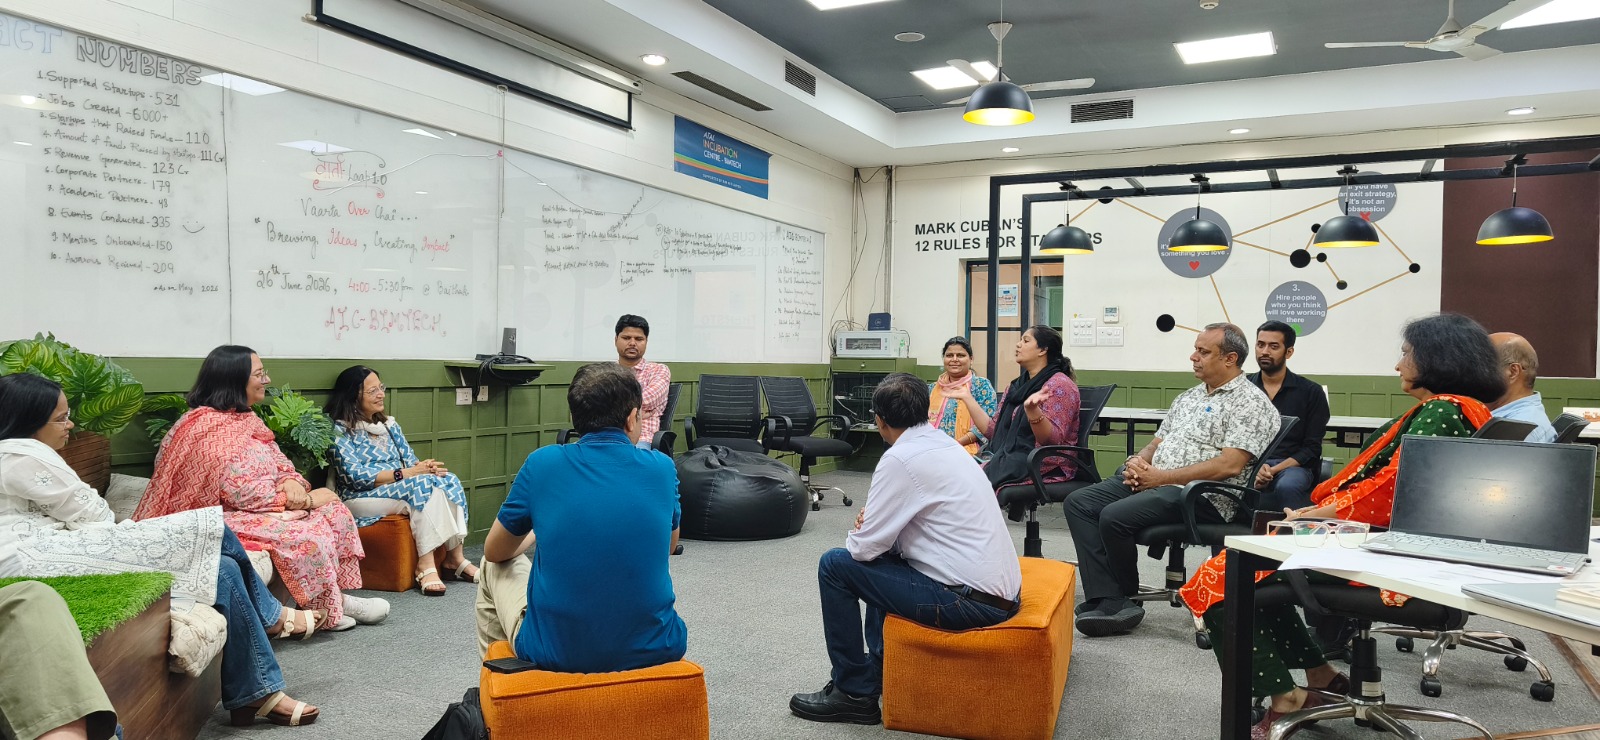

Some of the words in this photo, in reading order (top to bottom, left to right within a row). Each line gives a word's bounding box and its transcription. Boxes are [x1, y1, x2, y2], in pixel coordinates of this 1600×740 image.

[77, 36, 201, 85] NUMBERS
[103, 81, 146, 101] Startups
[47, 93, 75, 107] Jobs
[83, 99, 121, 117] Created
[49, 112, 85, 126] Startups
[91, 118, 111, 129] that
[117, 122, 145, 137] Raised
[186, 132, 210, 145] 110
[703, 131, 715, 141] ATAL
[54, 129, 88, 143] Amount
[92, 135, 100, 144] of
[130, 142, 158, 155] Raised
[162, 150, 170, 161] by
[703, 139, 738, 158] INCUBATION
[55, 147, 91, 161] Revenue
[153, 162, 175, 174] 123
[703, 150, 721, 162] CENTRE
[56, 165, 97, 180] Corporate
[152, 180, 170, 194] 179
[60, 184, 104, 199] Academic
[61, 208, 93, 220] Events
[301, 198, 342, 217] Vaarta
[348, 201, 370, 216] Over
[915, 222, 956, 235] MARK
[960, 218, 1022, 233] CUBN'S
[63, 233, 97, 246] Mentors
[915, 241, 929, 252] 12
[933, 238, 981, 251] RULES
[153, 262, 174, 274] 209
[179, 283, 193, 295] May
[281, 272, 303, 289] June
[348, 278, 370, 292] 4:00
[1292, 283, 1300, 291] 3.
[1292, 294, 1317, 302] people
[1297, 310, 1326, 318] working
